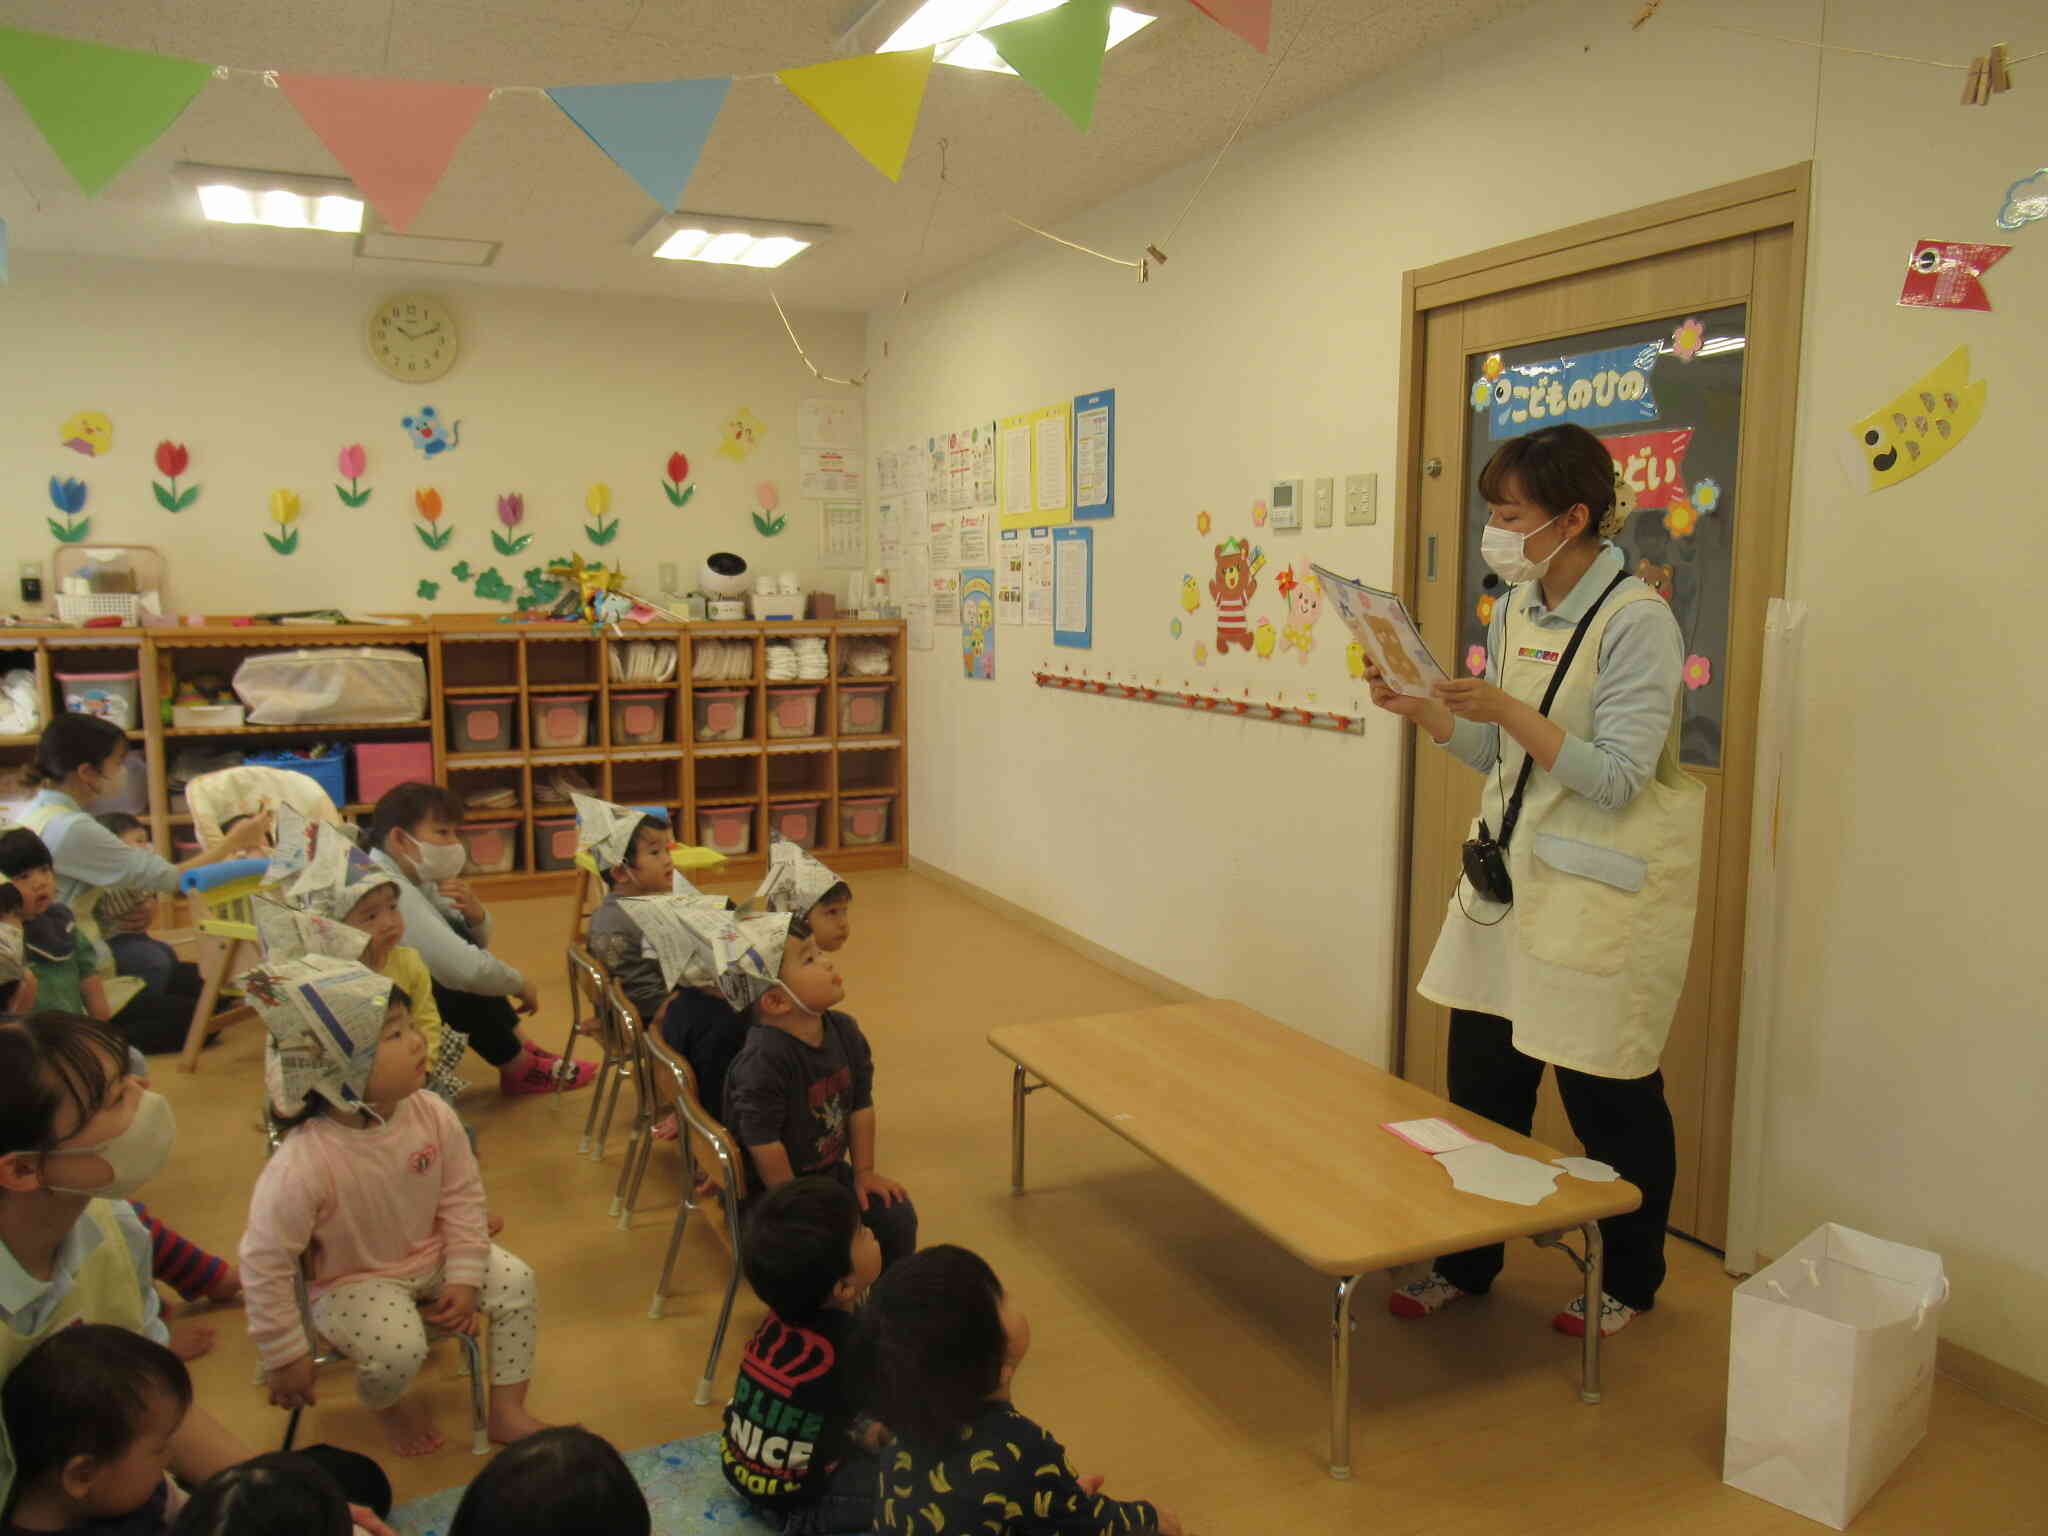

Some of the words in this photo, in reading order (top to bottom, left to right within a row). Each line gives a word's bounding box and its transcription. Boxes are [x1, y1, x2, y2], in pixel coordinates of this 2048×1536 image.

[1510, 369, 1647, 424] こどものひの
[1613, 446, 1677, 493] どい
[729, 1410, 815, 1472] NICE
